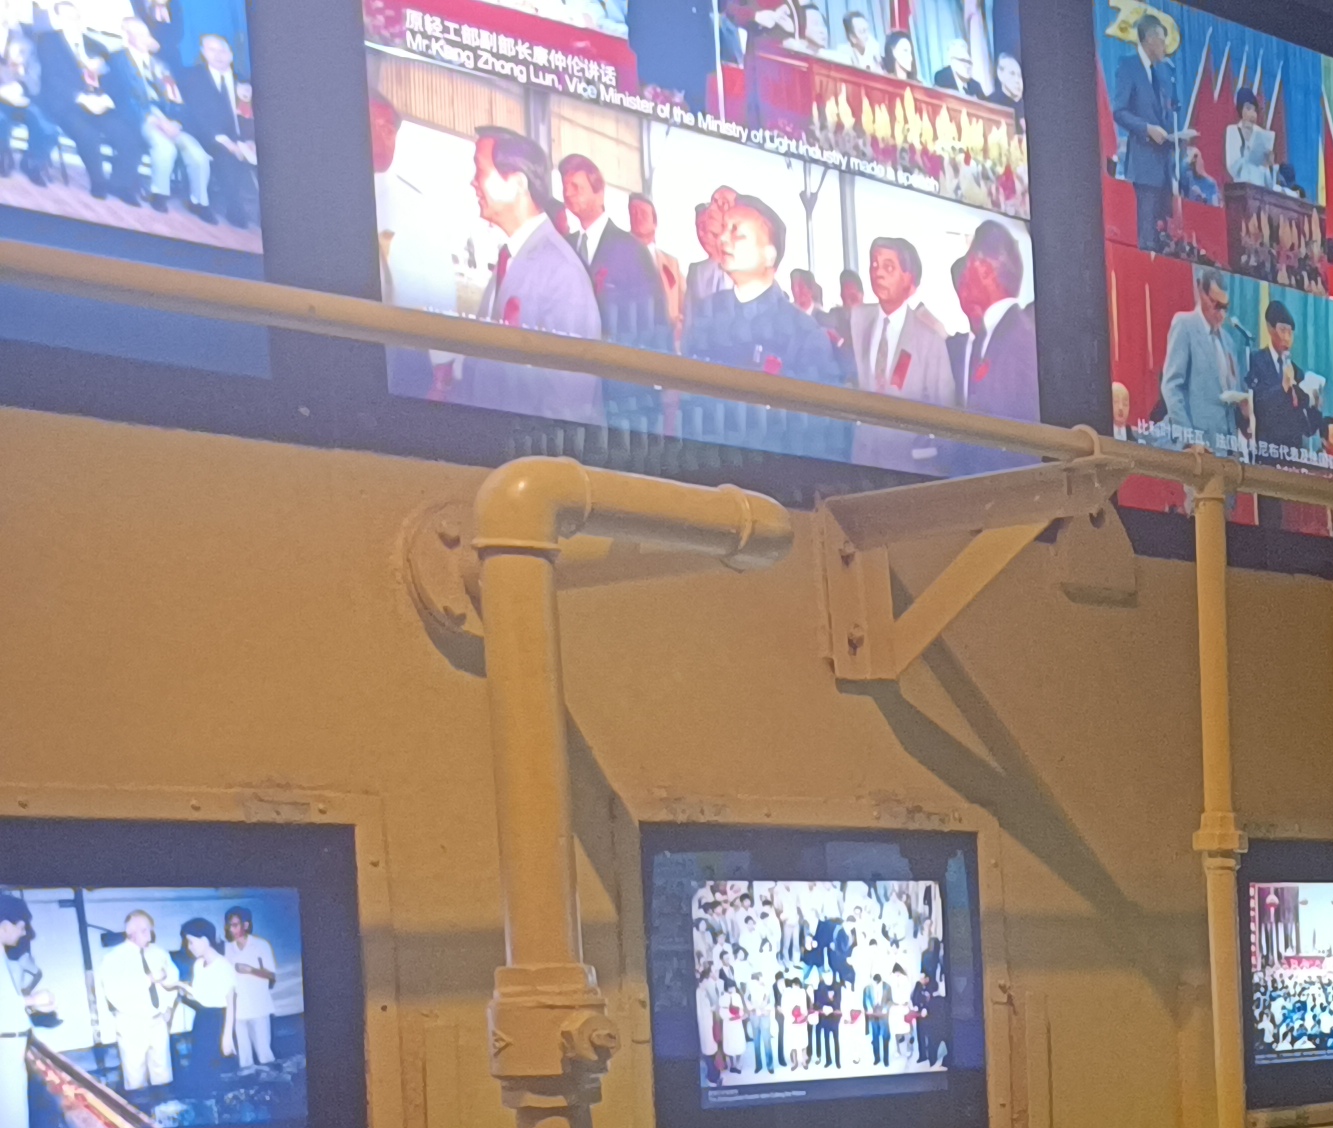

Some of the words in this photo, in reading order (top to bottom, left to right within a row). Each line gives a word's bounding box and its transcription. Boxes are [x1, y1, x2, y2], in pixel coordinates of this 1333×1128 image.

[405, 8, 617, 86] 原轻工部副部长康仲伦讲话
[477, 50, 528, 83] Zhong
[565, 75, 598, 100] Vice
[599, 84, 655, 115] Minister
[656, 102, 671, 118] of
[673, 105, 695, 126] the
[697, 111, 749, 143] Ministry
[750, 128, 764, 144] of
